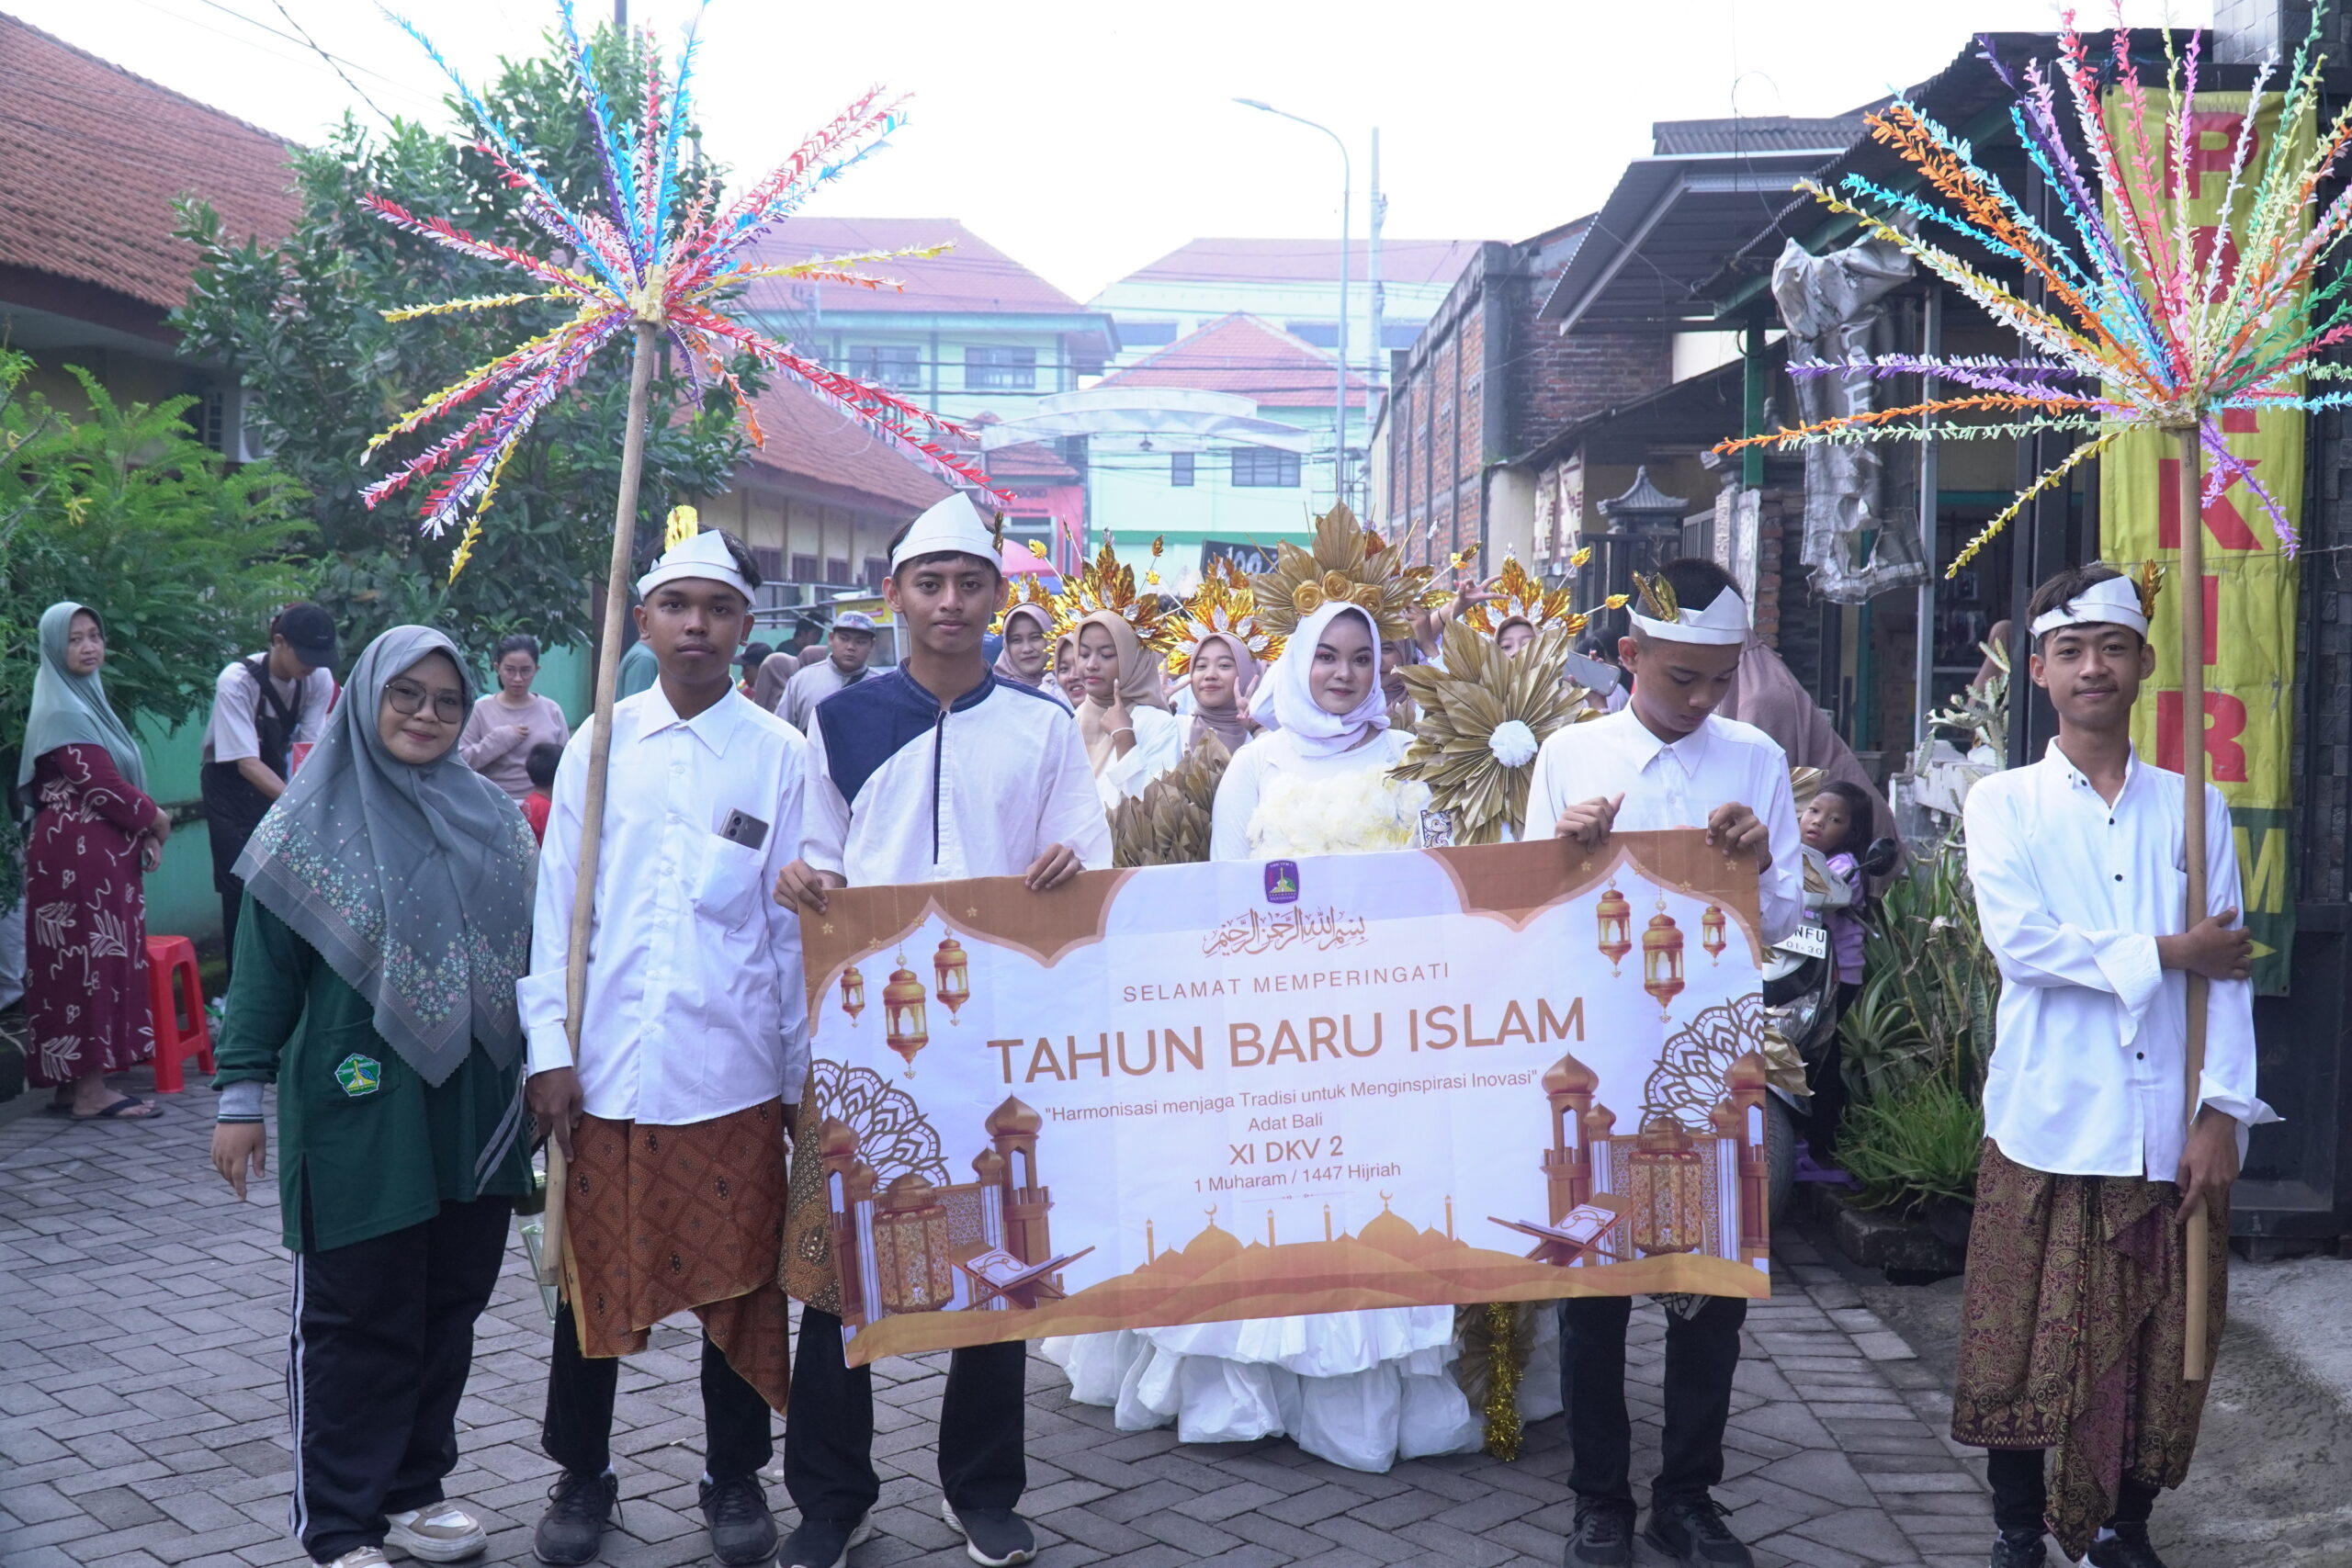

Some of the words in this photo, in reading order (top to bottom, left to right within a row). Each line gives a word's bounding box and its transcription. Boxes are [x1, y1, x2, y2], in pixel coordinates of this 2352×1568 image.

[2156, 110, 2264, 783] PAKIR
[1123, 978, 1241, 1003] SELAMAT
[1253, 962, 1448, 994] MEMPERINGATI
[986, 1025, 1204, 1085] TAHUN
[1228, 1011, 1383, 1068] BARU
[1408, 996, 1585, 1053] ISLAM
[1045, 1099, 1158, 1122] "Harmonisasi
[1162, 1096, 1236, 1115] menjaga
[1238, 1089, 1296, 1109] Tradisi
[1301, 1083, 1346, 1103] untuk
[1351, 1073, 1467, 1098] Menginspirasi
[1472, 1068, 1537, 1089] Inovasi"
[1248, 1116, 1287, 1133] Adat
[1292, 1112, 1323, 1129] Bali
[1228, 1143, 1255, 1166] XI
[1265, 1137, 1321, 1164] DKV
[1329, 1134, 1344, 1157] 2
[1193, 1179, 1201, 1193] 1
[1208, 1173, 1287, 1192] Muharam
[1303, 1165, 1343, 1183] 1447
[1348, 1161, 1401, 1182] Hijriah
